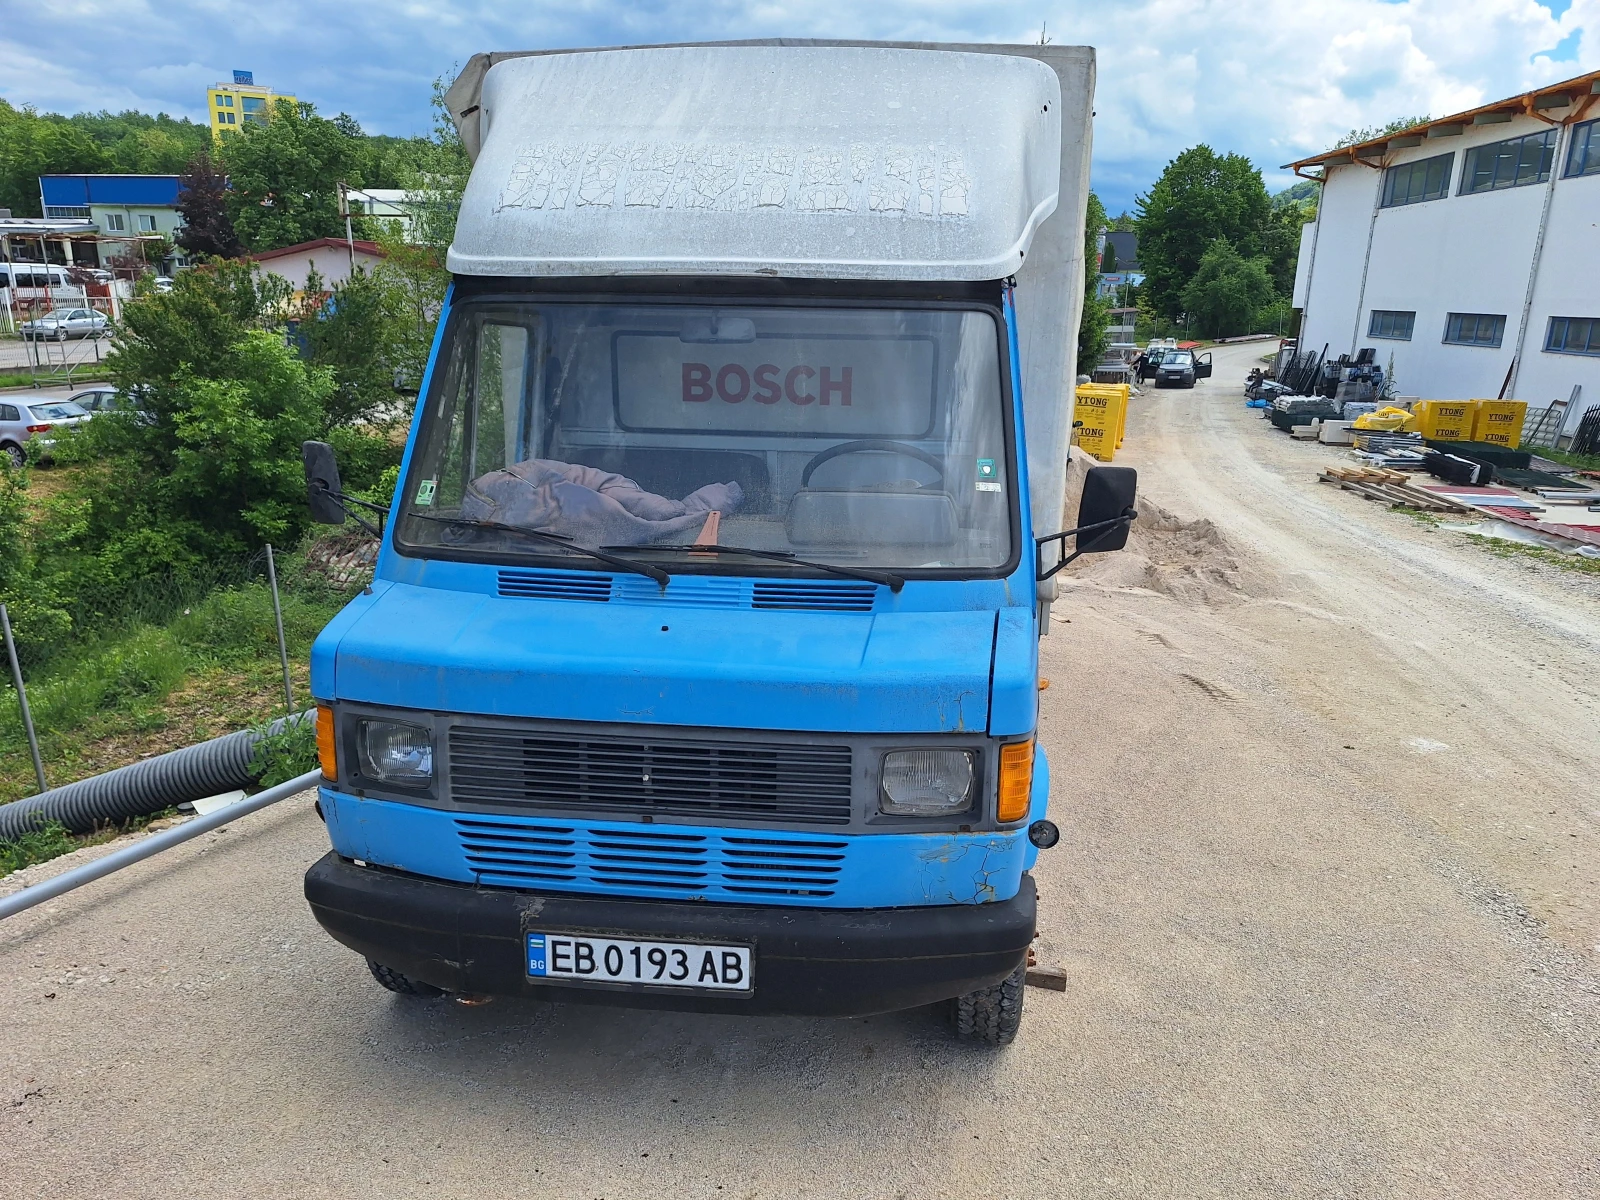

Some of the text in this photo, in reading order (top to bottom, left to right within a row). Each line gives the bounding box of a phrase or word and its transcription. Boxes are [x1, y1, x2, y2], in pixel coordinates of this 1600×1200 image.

[682, 363, 852, 406] BOSCH
[1077, 396, 1107, 406] YTONG
[1439, 407, 1464, 416] YTONG
[1488, 413, 1514, 421] YTONG
[1077, 428, 1104, 437] TONG
[1435, 428, 1460, 437] YTONG
[1485, 433, 1510, 441] YTONG
[530, 959, 545, 970] BG
[551, 940, 743, 984] EB 0193 AB
